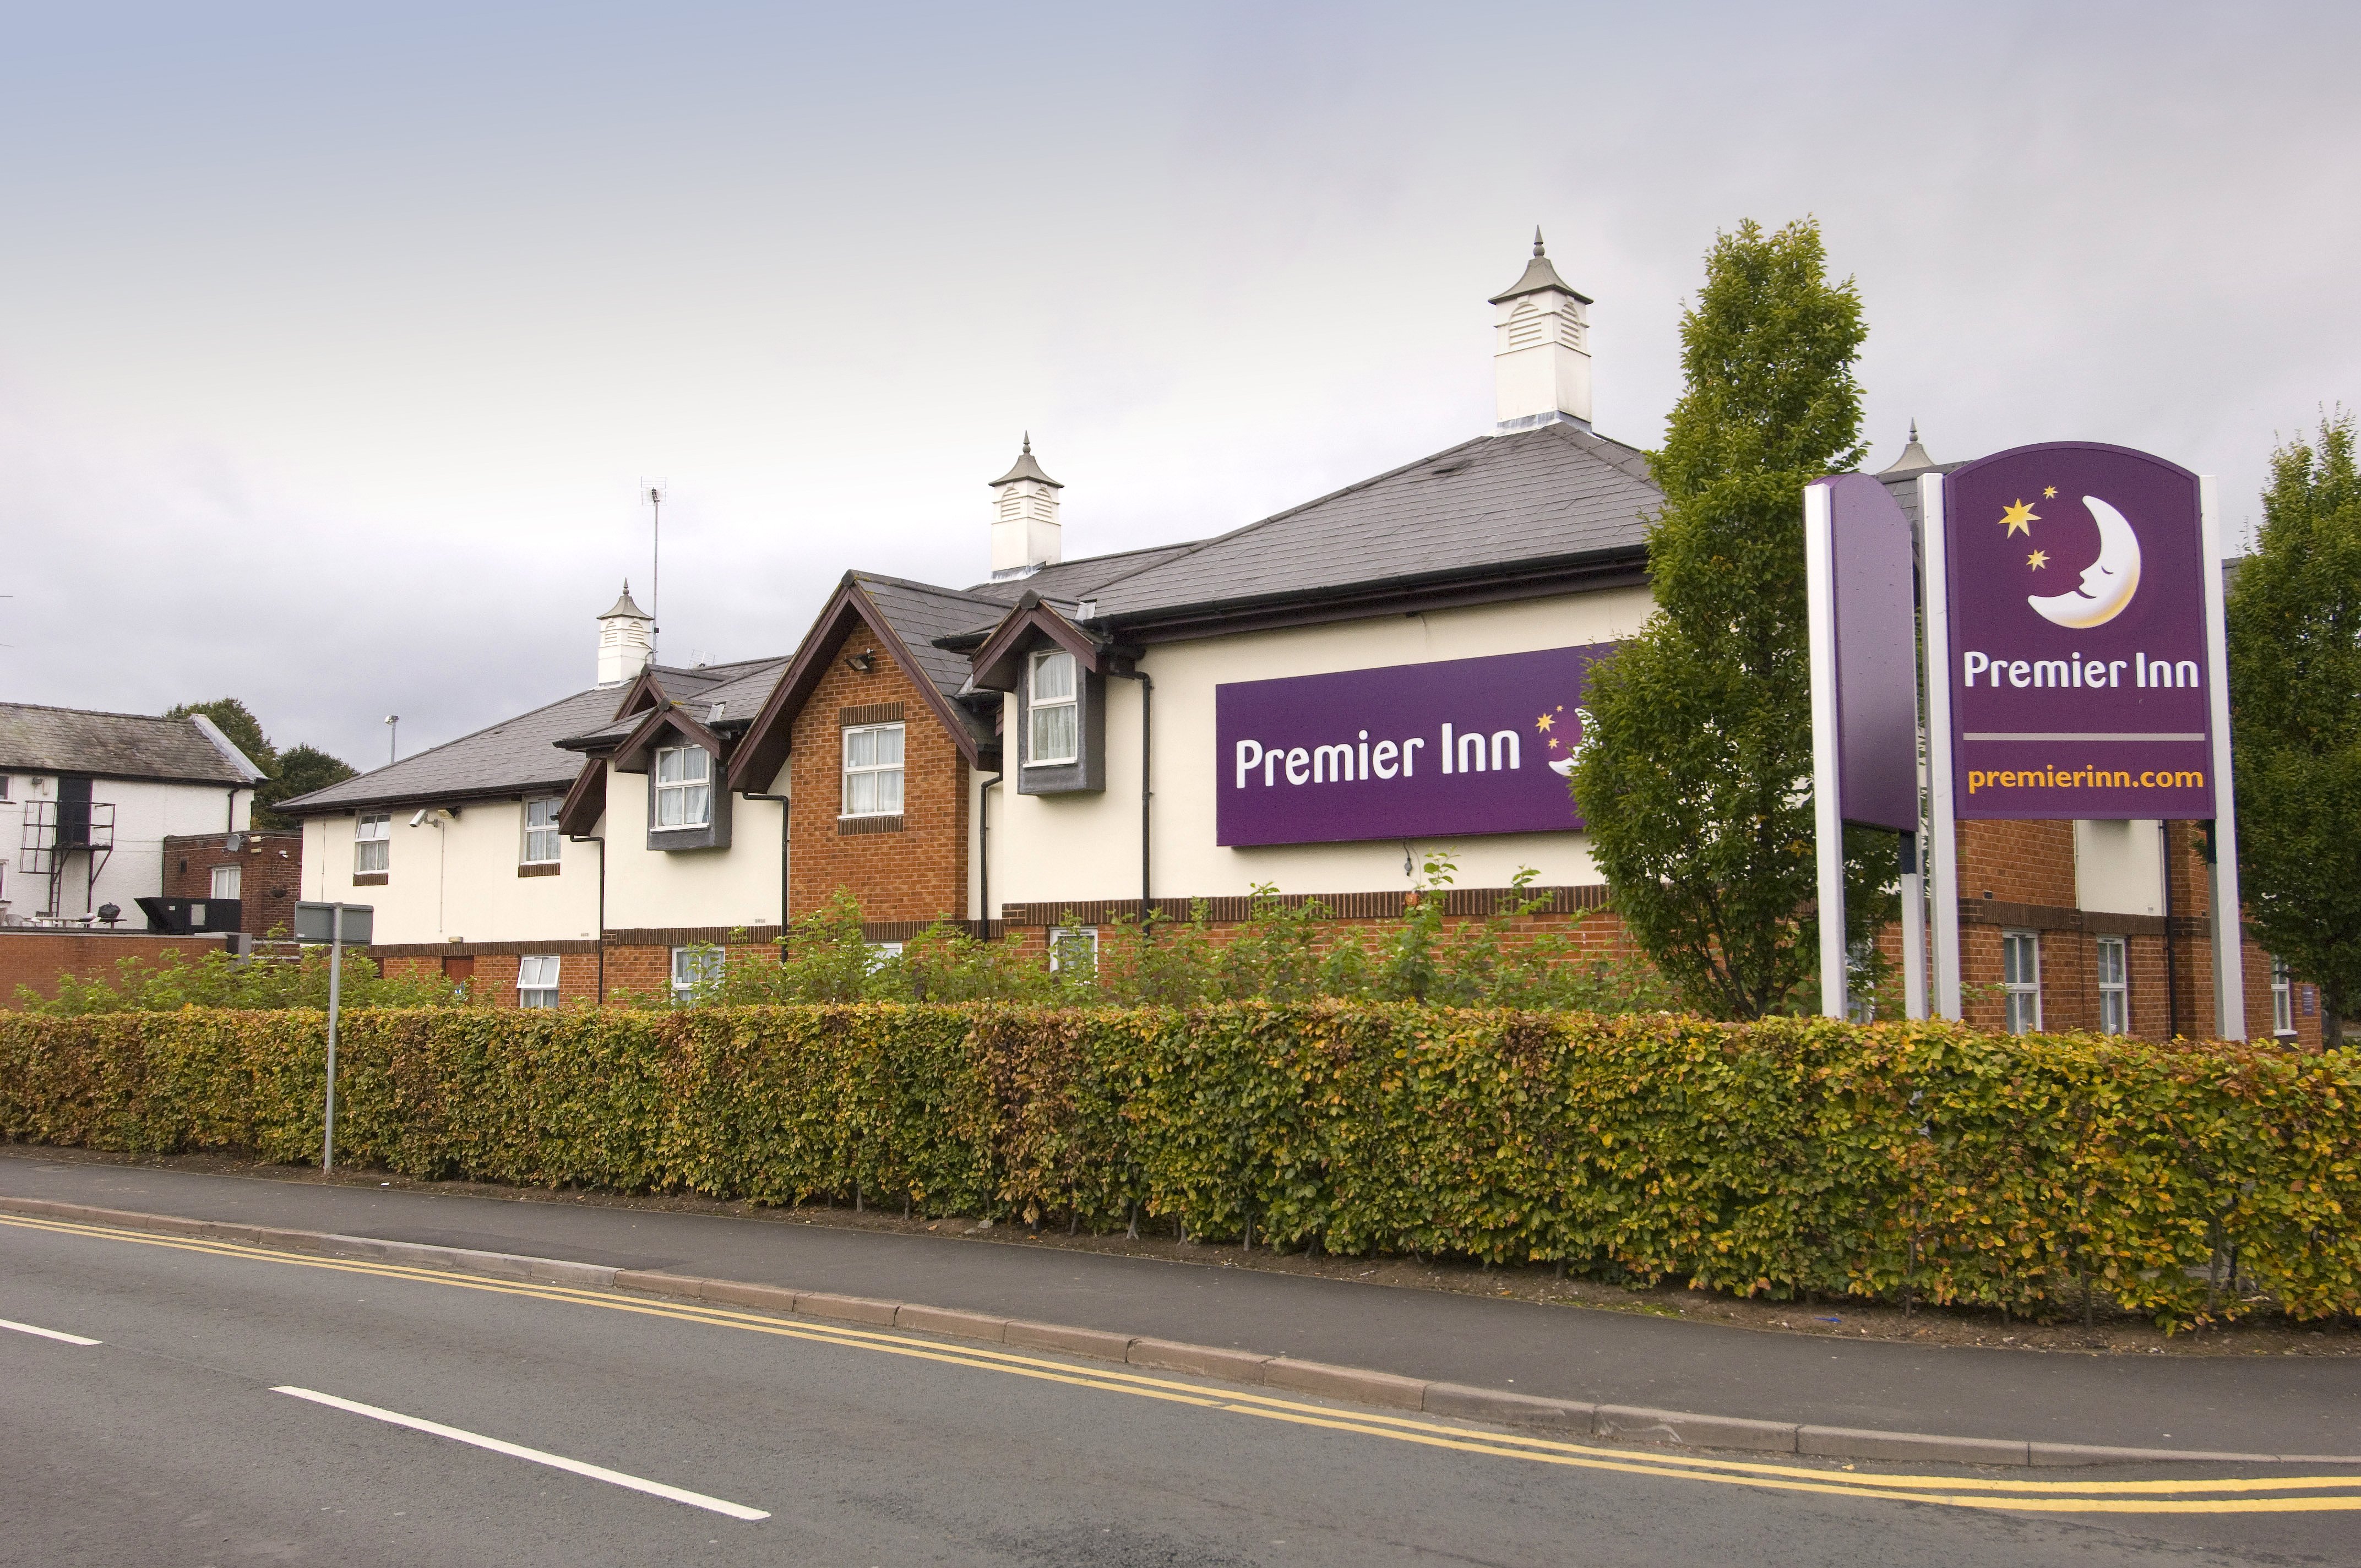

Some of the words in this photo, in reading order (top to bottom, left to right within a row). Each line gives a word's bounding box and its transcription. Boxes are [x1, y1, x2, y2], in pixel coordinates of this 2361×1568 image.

[1964, 651, 2127, 688] Premier
[2136, 652, 2199, 688] Inn
[1236, 729, 1424, 789] Premier
[1441, 722, 1520, 774] Inn
[1968, 764, 2204, 794] premierinn.com
